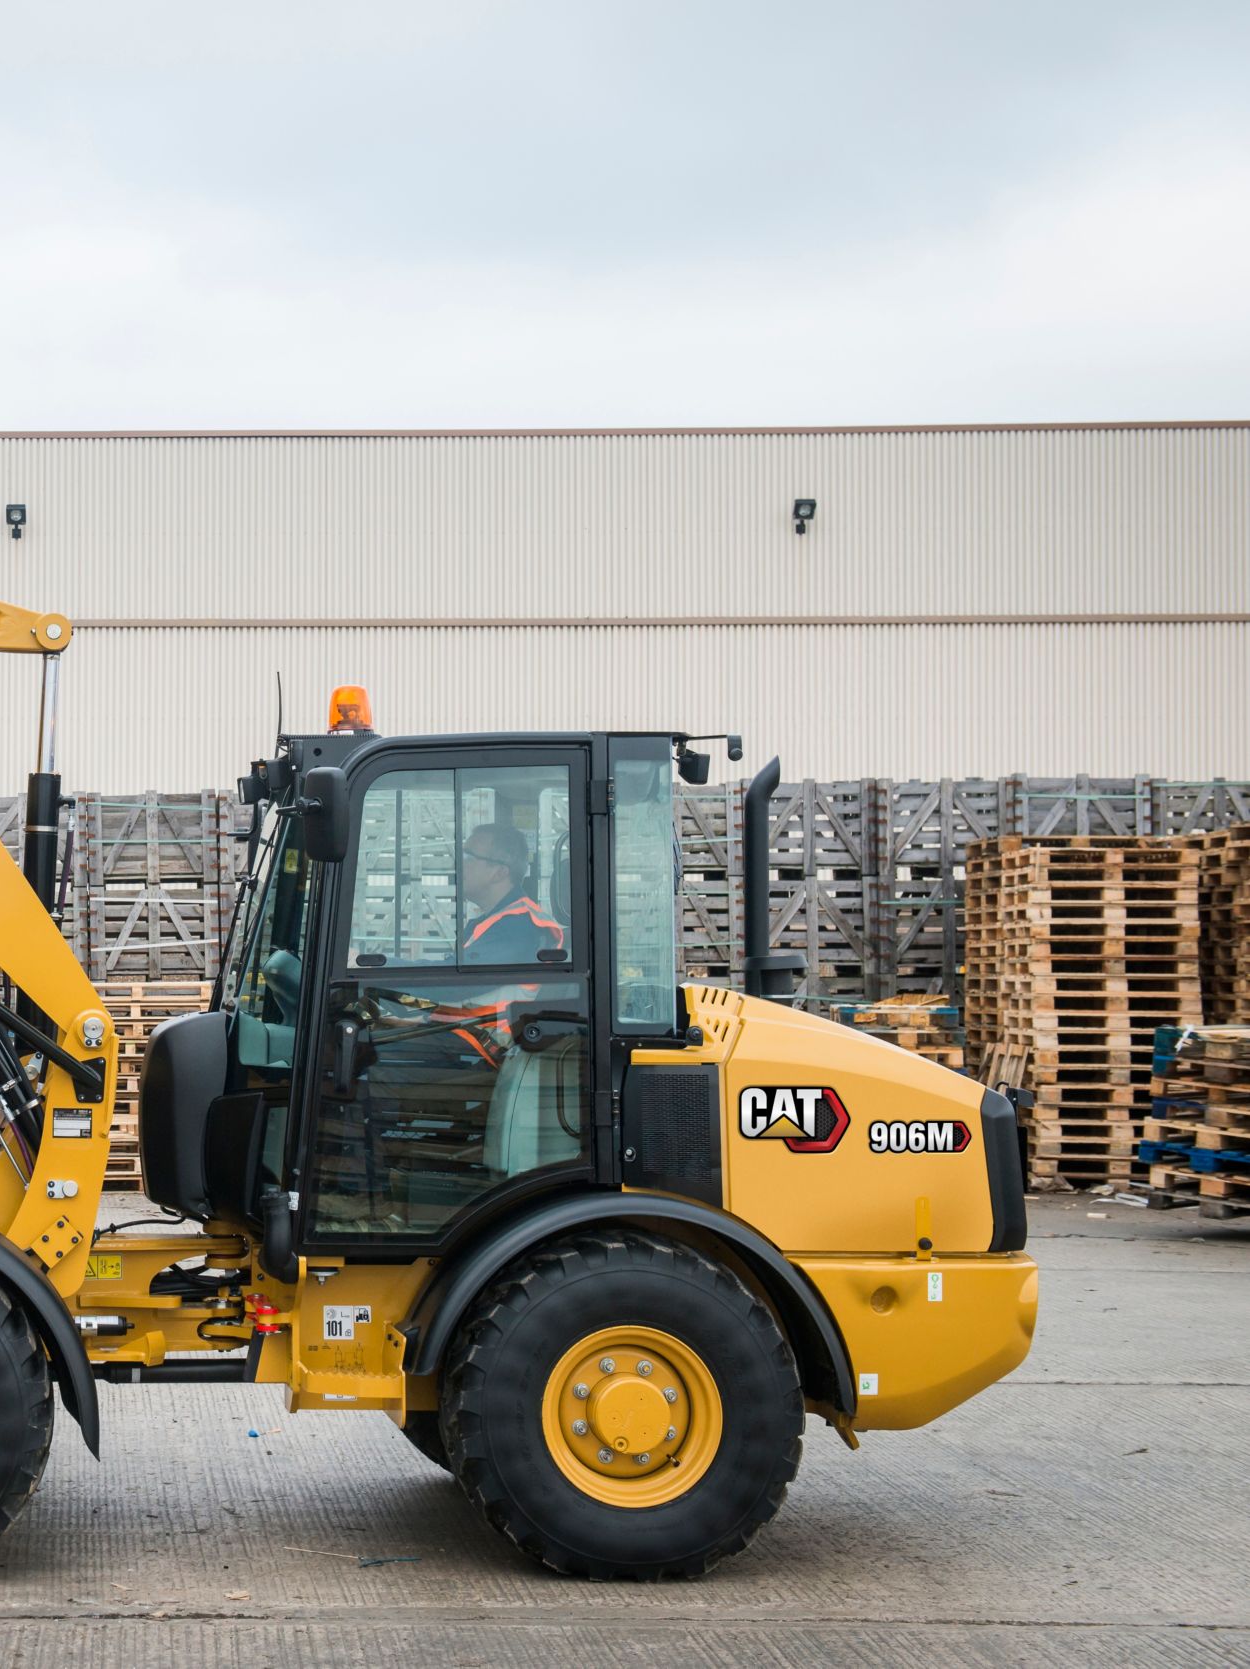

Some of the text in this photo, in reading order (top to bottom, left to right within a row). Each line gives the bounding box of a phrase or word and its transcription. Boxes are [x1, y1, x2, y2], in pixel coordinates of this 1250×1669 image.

[740, 1087, 823, 1138] CAT
[870, 1121, 954, 1152] 906M
[326, 1320, 343, 1337] 101
